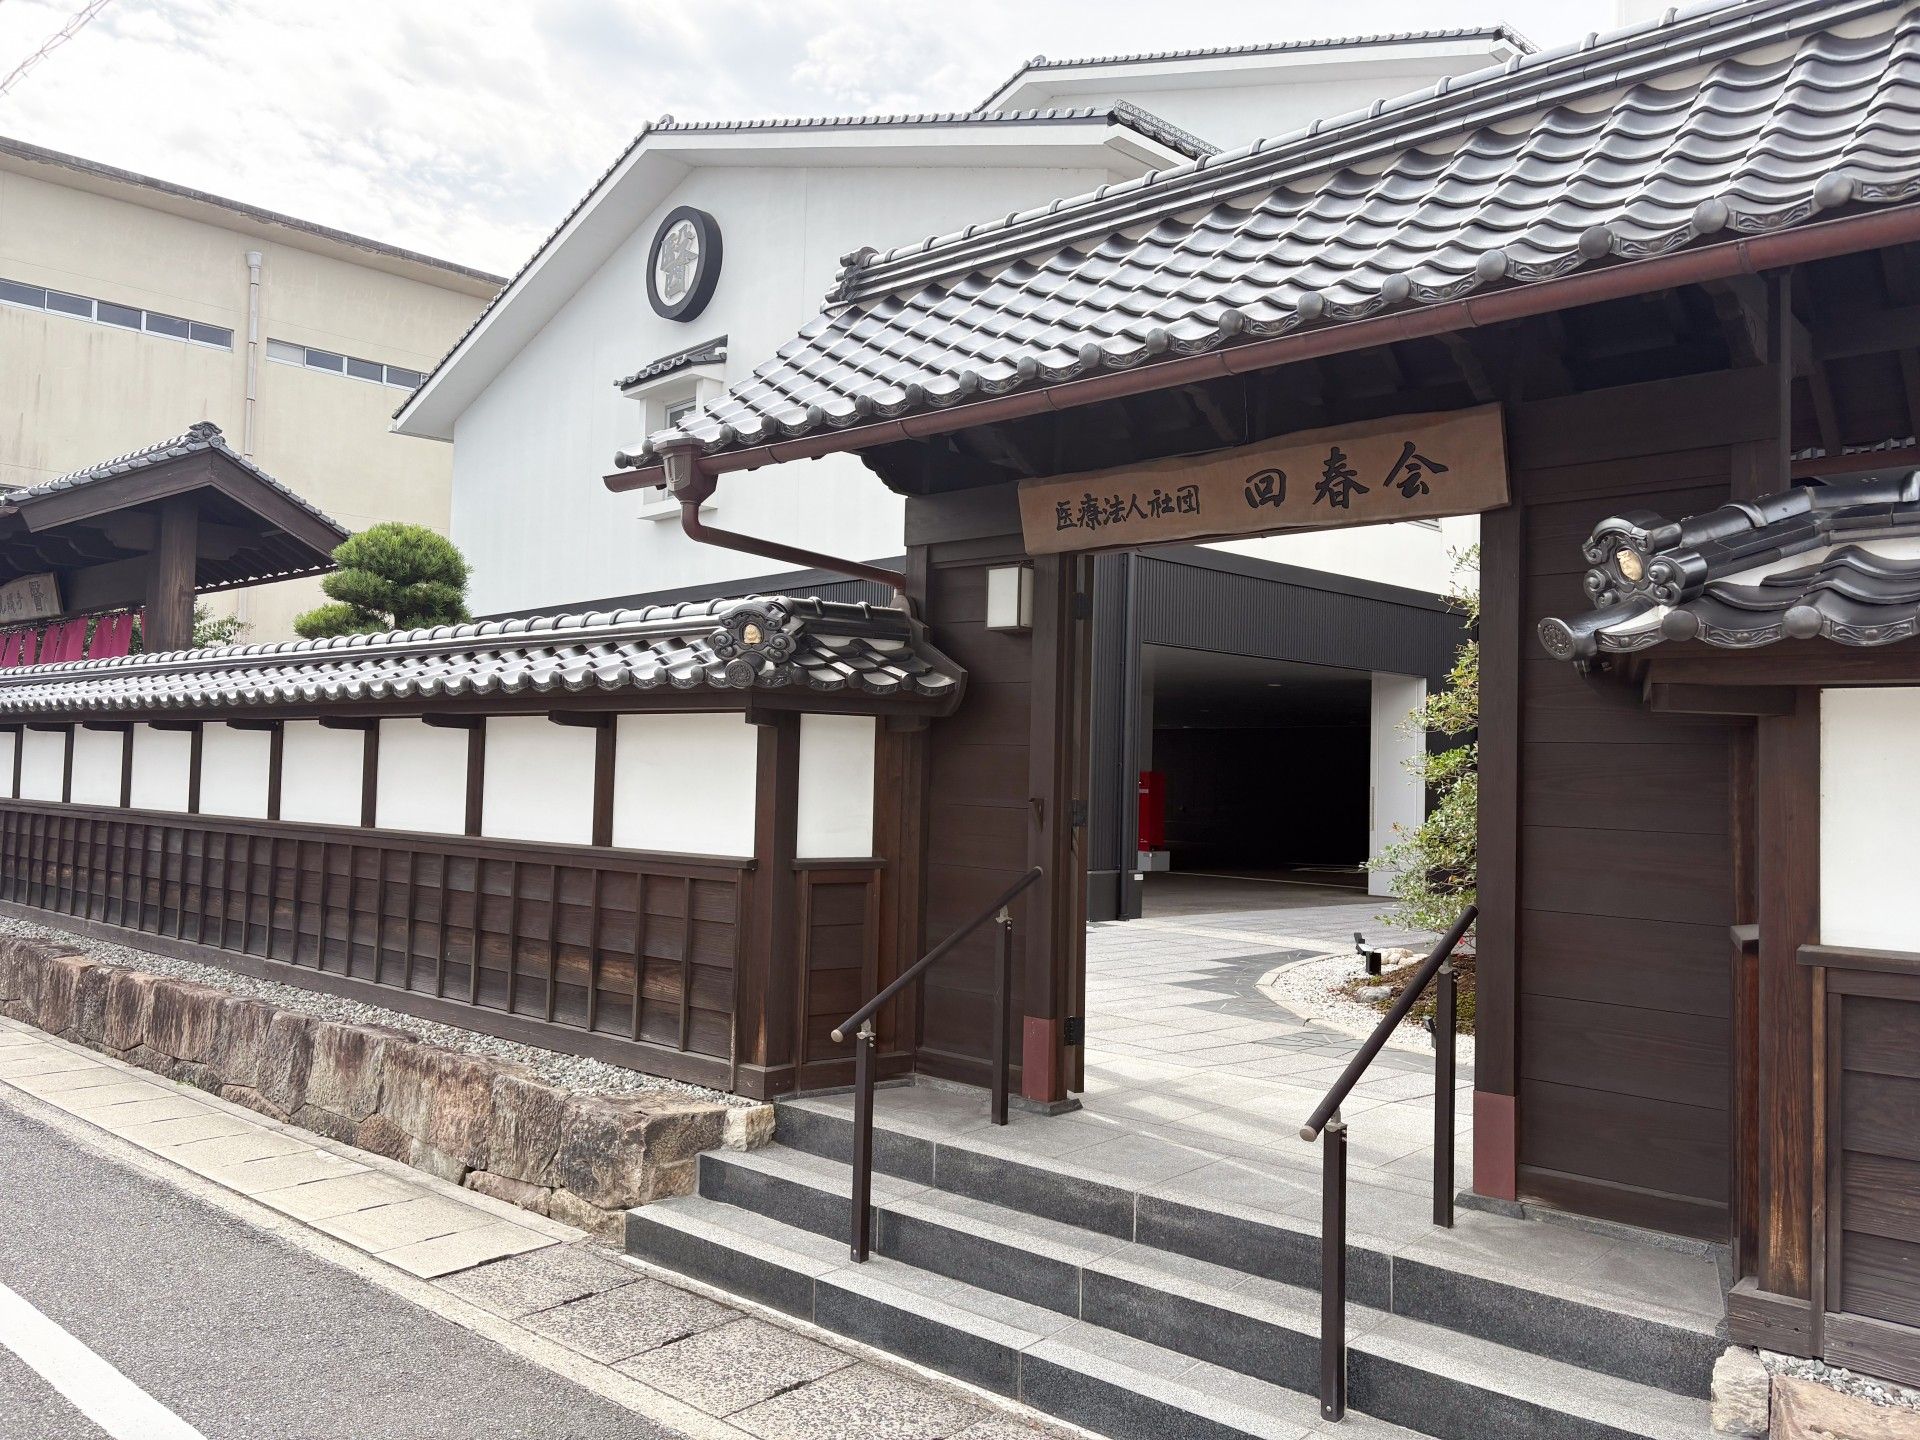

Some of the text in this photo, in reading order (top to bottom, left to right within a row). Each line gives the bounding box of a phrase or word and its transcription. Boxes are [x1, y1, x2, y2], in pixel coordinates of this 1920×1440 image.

[1055, 441, 1448, 531] 医療法人社団 回春会
